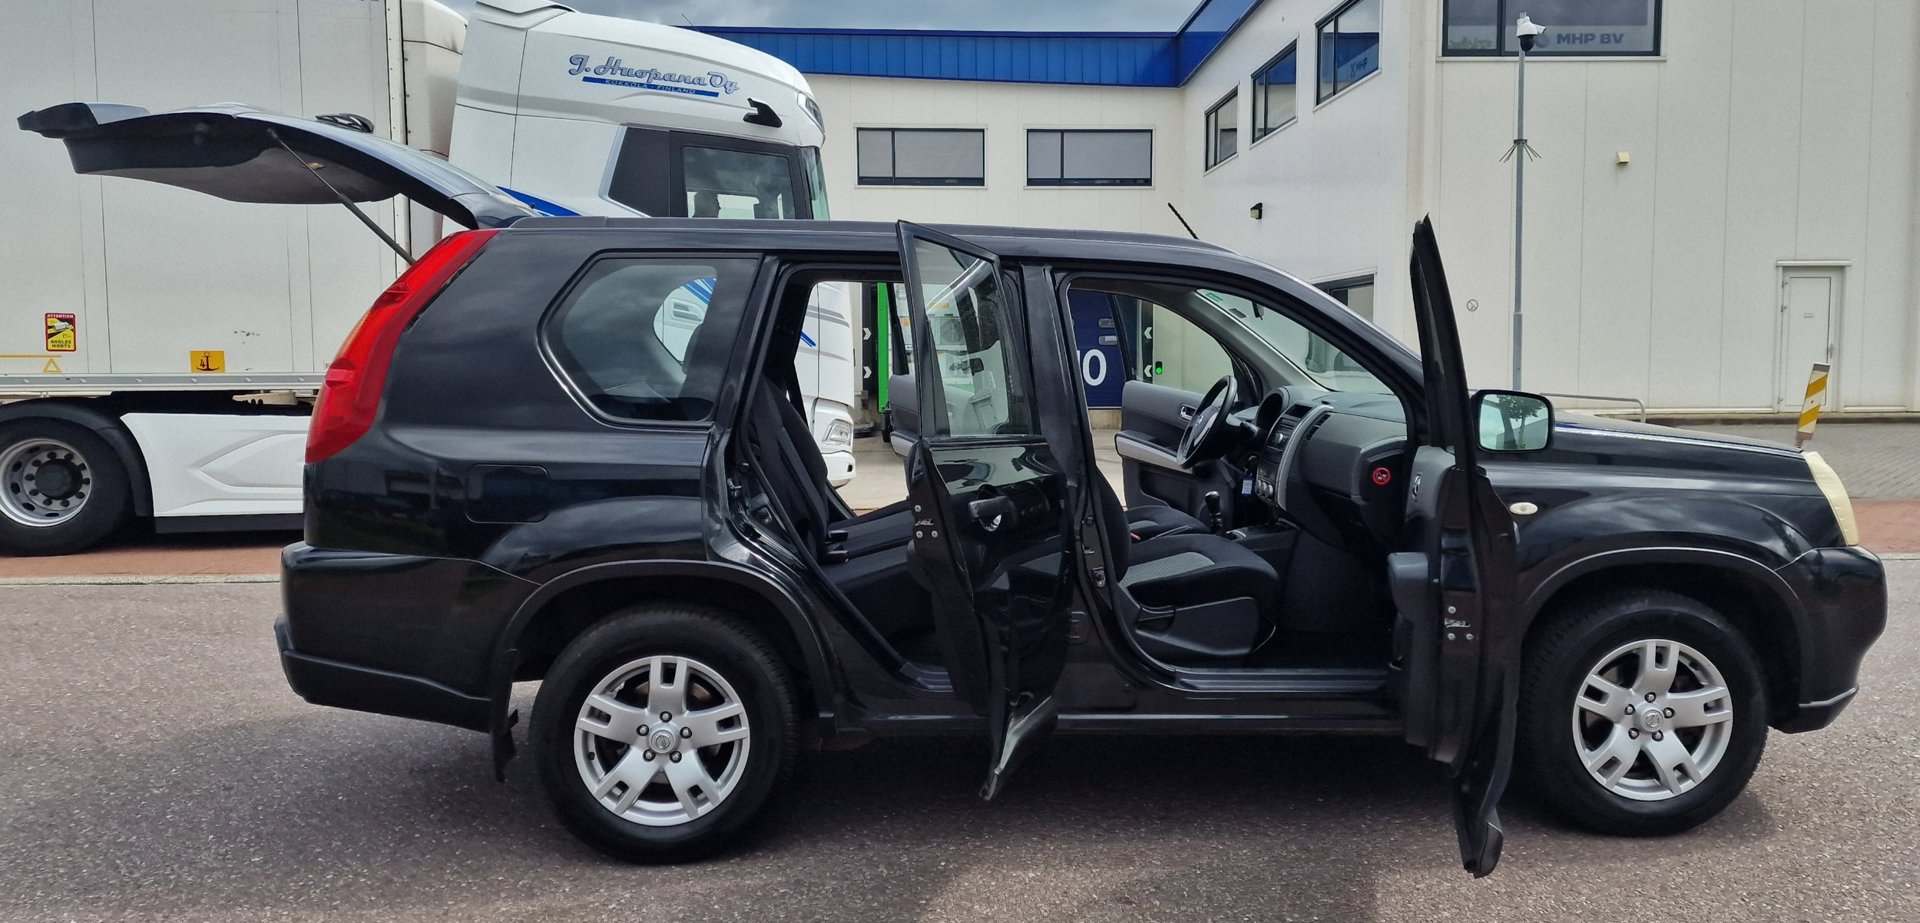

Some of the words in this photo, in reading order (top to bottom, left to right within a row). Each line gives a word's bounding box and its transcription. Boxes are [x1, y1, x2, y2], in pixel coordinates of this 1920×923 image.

[1557, 33, 1596, 45] MHP
[594, 56, 708, 84] Huopana
[707, 71, 741, 95] Oy
[605, 79, 648, 89] KOKKOLA
[656, 85, 695, 94] FINLAND
[200, 359, 206, 368] 4
